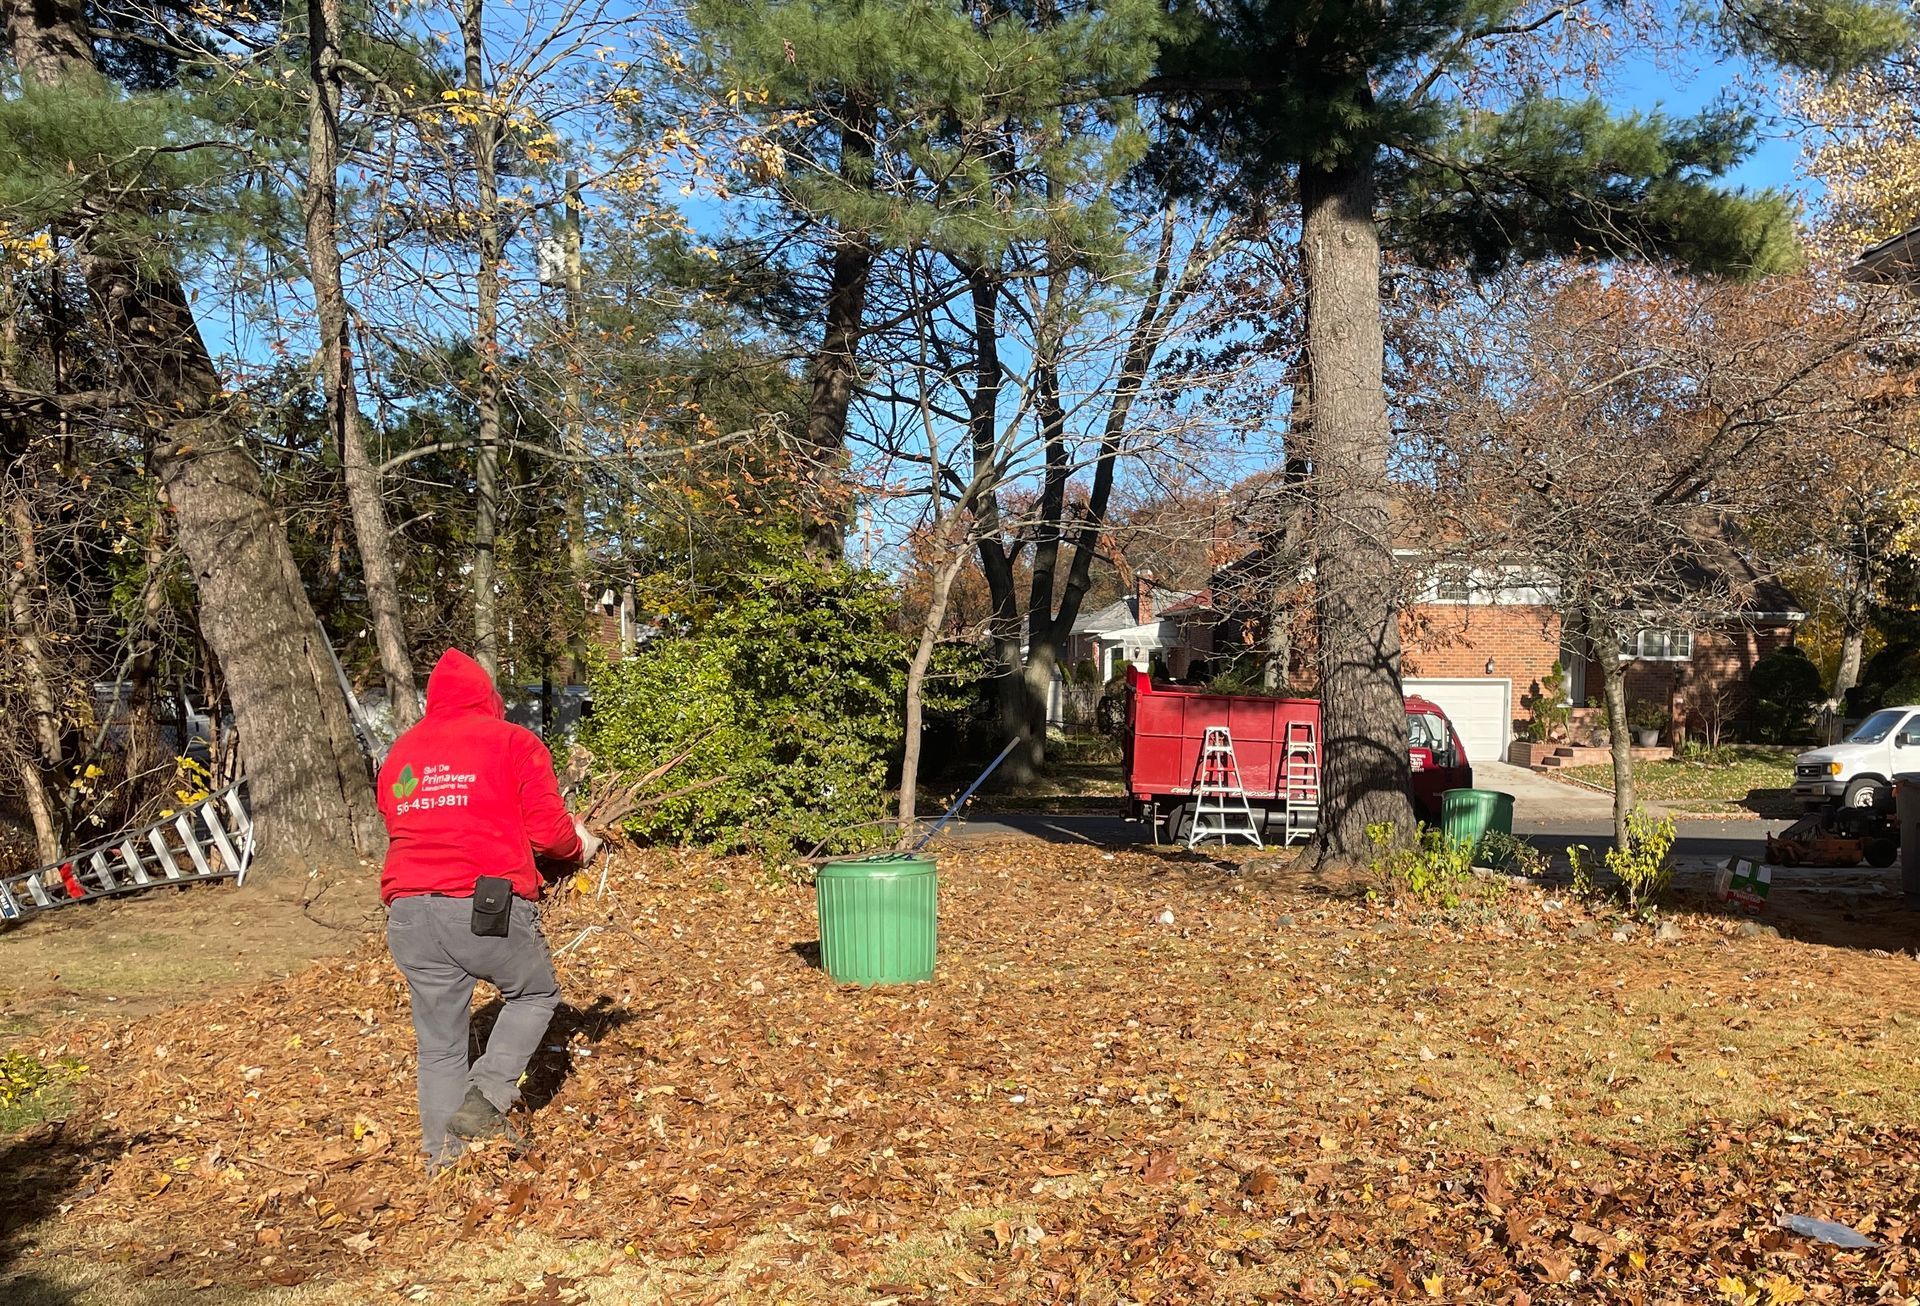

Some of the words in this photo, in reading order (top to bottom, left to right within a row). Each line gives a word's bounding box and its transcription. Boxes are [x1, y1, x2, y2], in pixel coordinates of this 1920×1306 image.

[438, 764, 450, 772] De
[422, 774, 476, 785] Primavera
[396, 795, 468, 815] 56-451-9811
